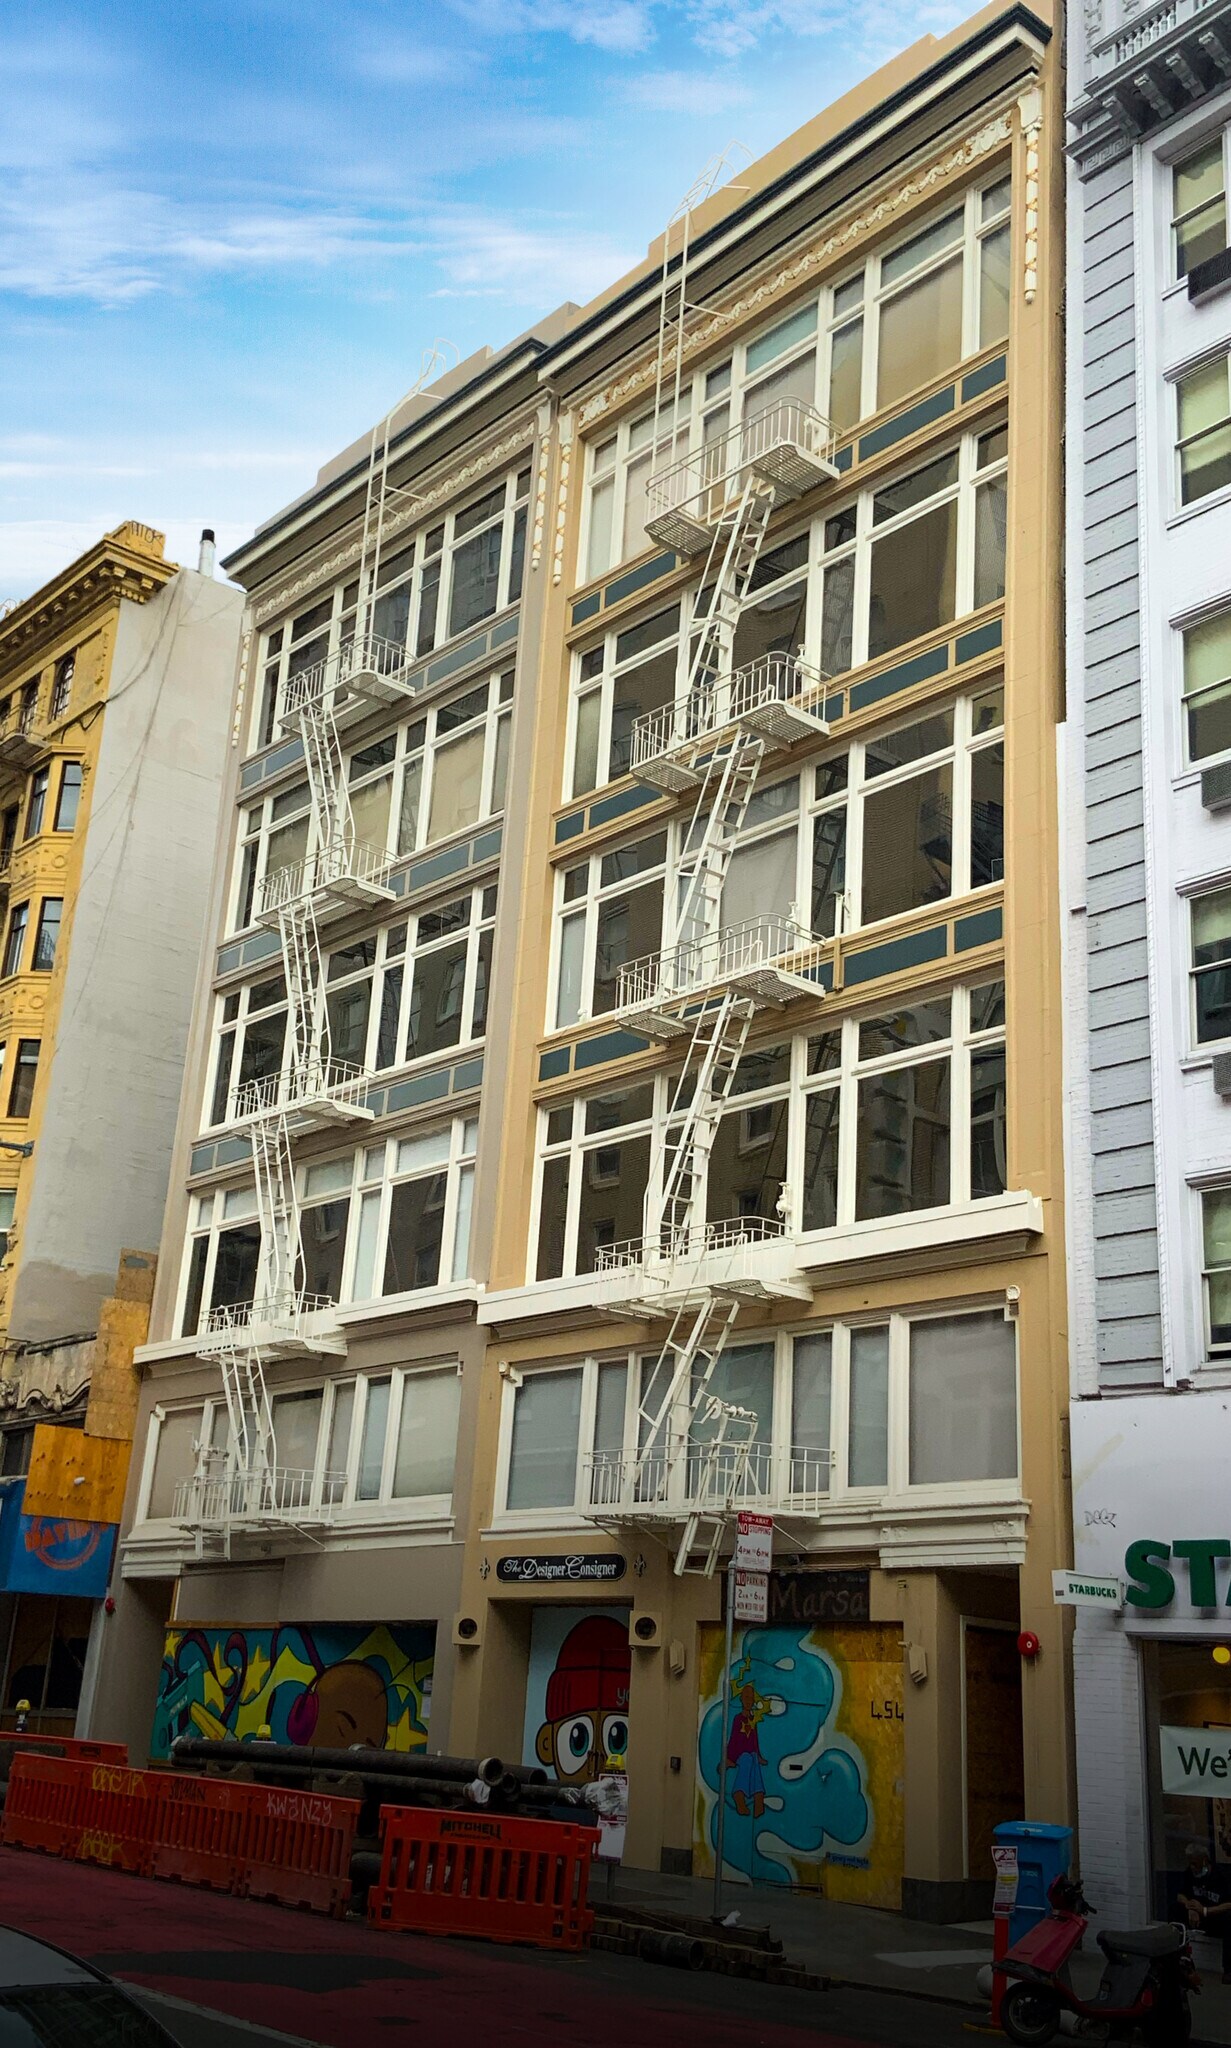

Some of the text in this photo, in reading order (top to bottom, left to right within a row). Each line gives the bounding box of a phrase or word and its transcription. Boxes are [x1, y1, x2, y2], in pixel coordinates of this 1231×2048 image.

[741, 1514, 770, 1524] TOW-AWAY
[738, 1522, 771, 1536] NO STOPPING
[503, 1555, 617, 1579] The Designer Consigner
[1125, 1539, 1231, 1609] ST
[736, 1571, 767, 1587] NO PARKING
[1068, 1583, 1117, 1598] STARBUCKS
[871, 1700, 904, 1722] 454
